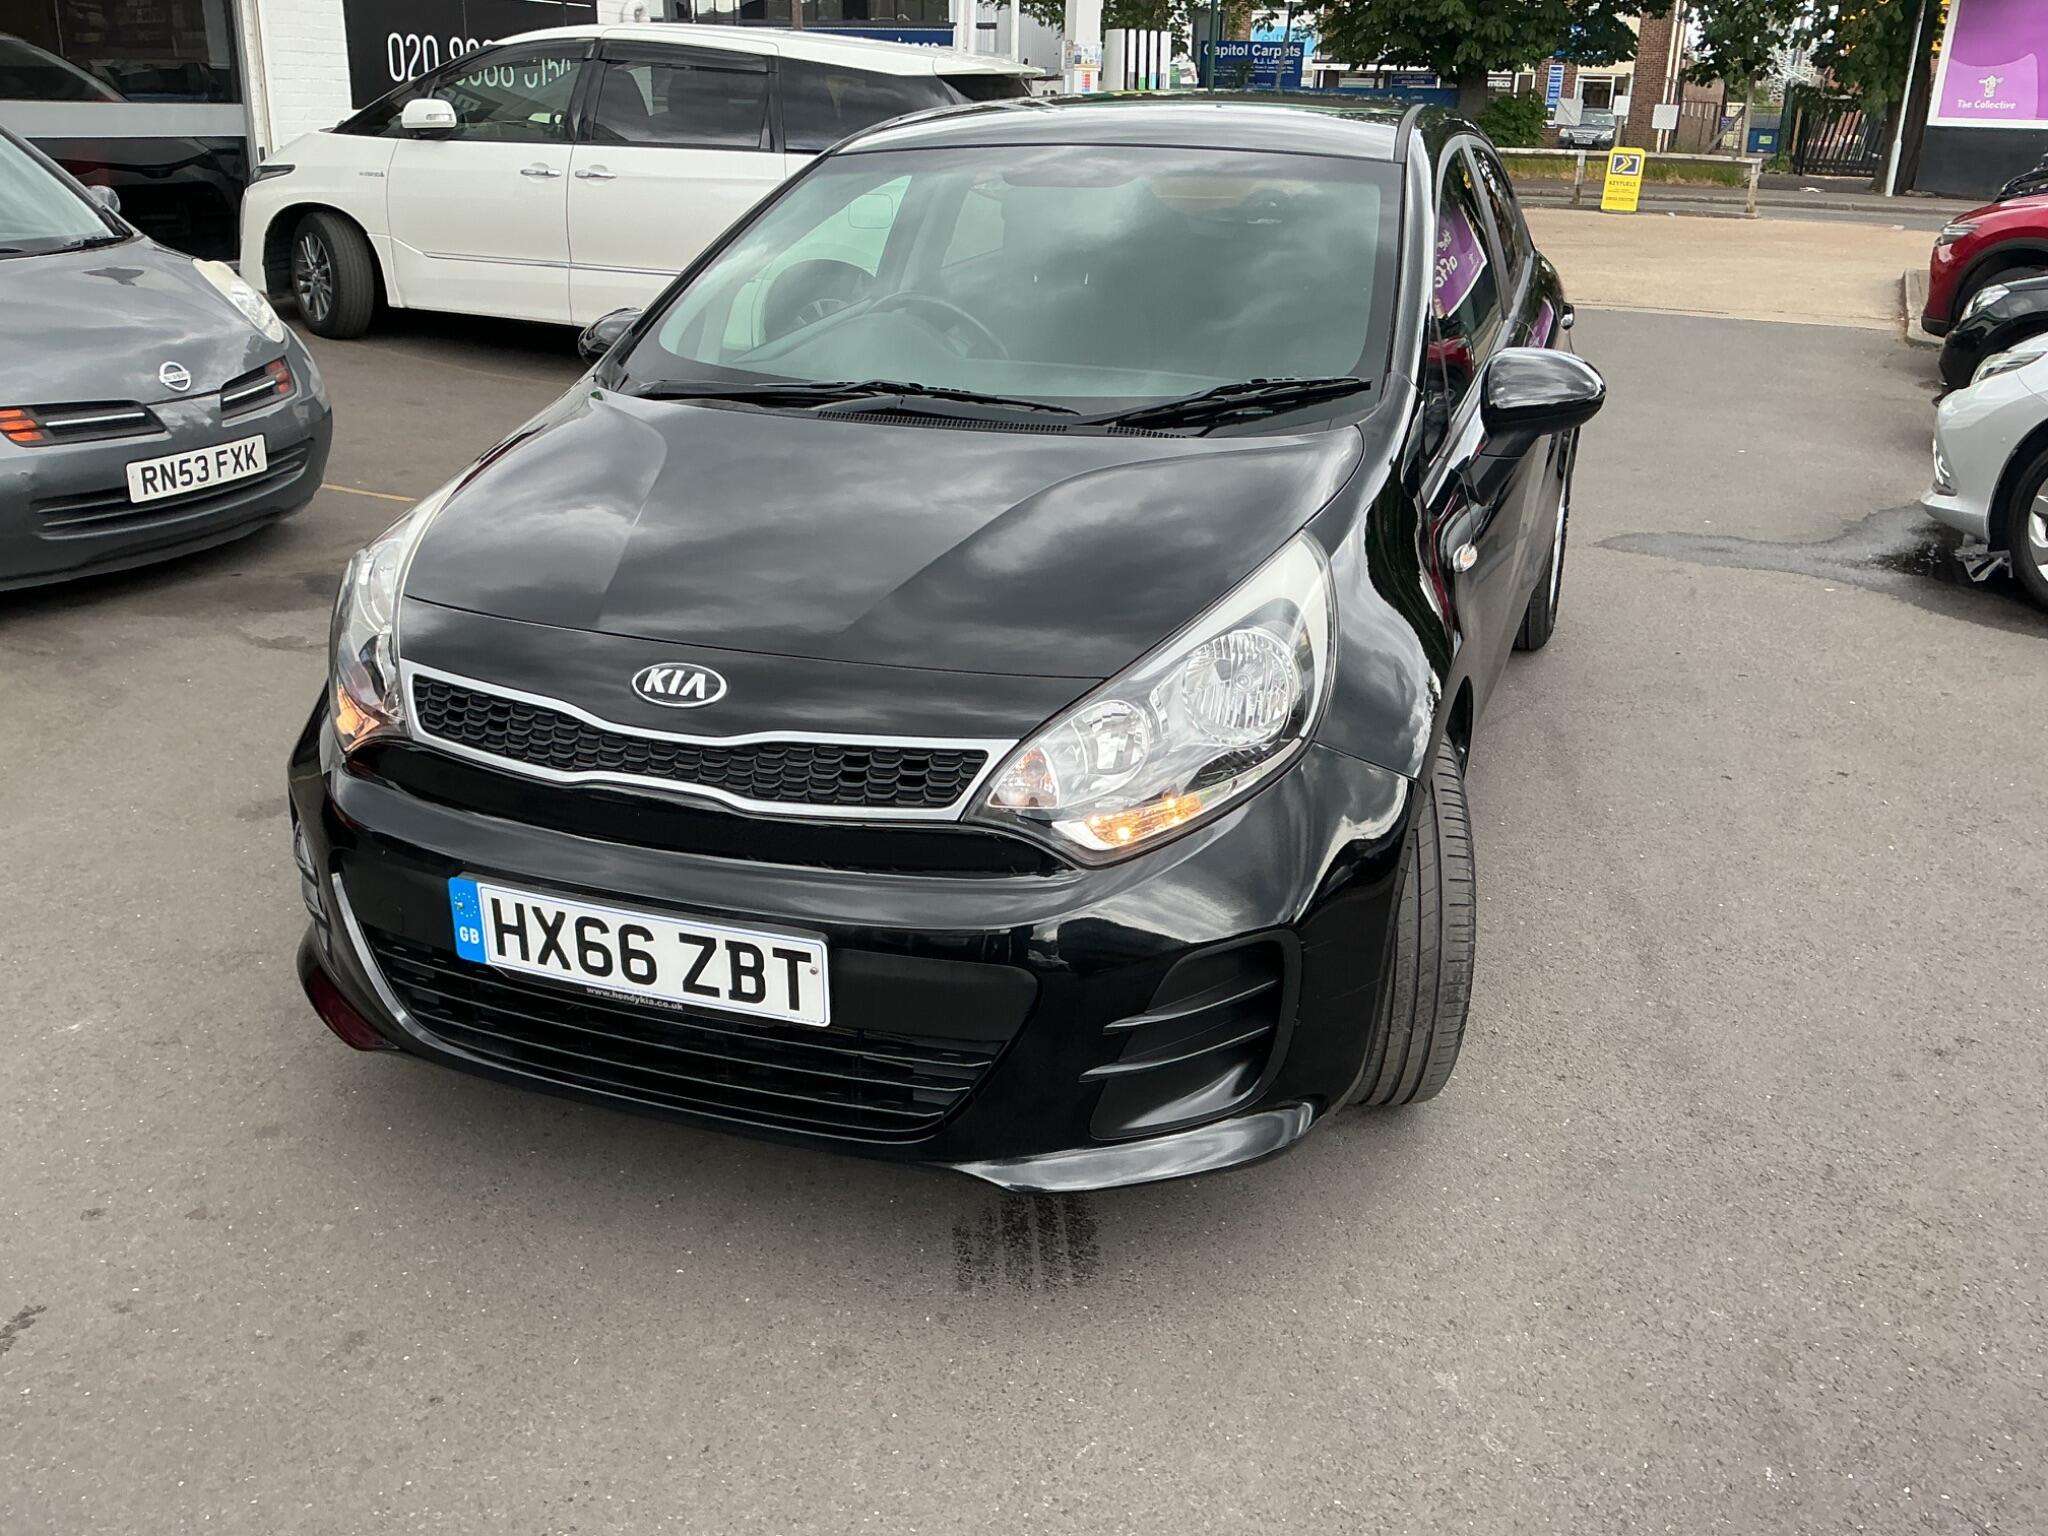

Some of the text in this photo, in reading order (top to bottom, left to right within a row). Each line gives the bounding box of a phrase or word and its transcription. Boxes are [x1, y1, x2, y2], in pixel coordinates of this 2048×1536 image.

[387, 32, 441, 82] 020
[1957, 100, 2017, 110] The Collective
[140, 442, 258, 495] RN53 FXK
[643, 668, 706, 699] KIA
[459, 926, 480, 945] GB
[490, 897, 812, 1011] HX66 ZBT
